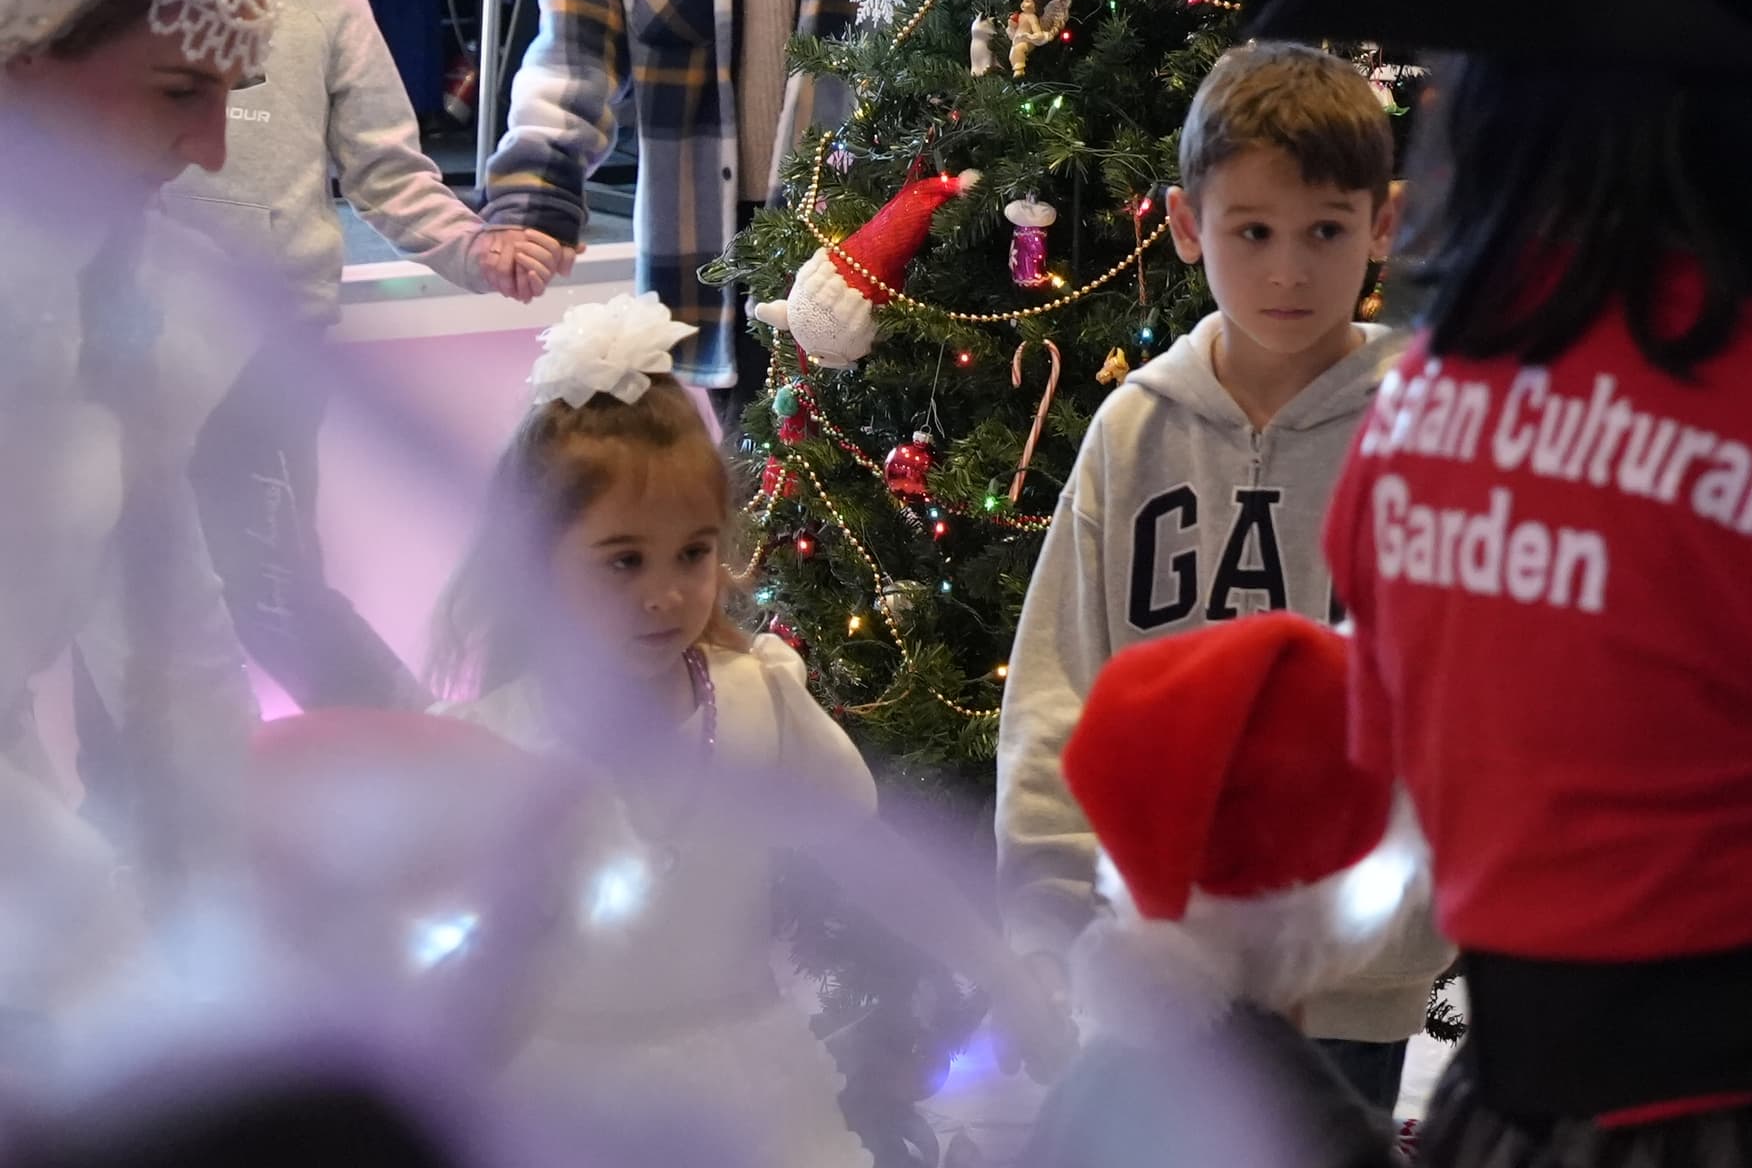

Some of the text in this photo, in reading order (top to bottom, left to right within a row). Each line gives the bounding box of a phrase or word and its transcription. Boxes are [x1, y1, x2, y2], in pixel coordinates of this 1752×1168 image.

[226, 106, 271, 123] OUR
[1360, 358, 1490, 462] sian
[1127, 484, 1351, 631] GA
[1372, 473, 1609, 613] Garden
